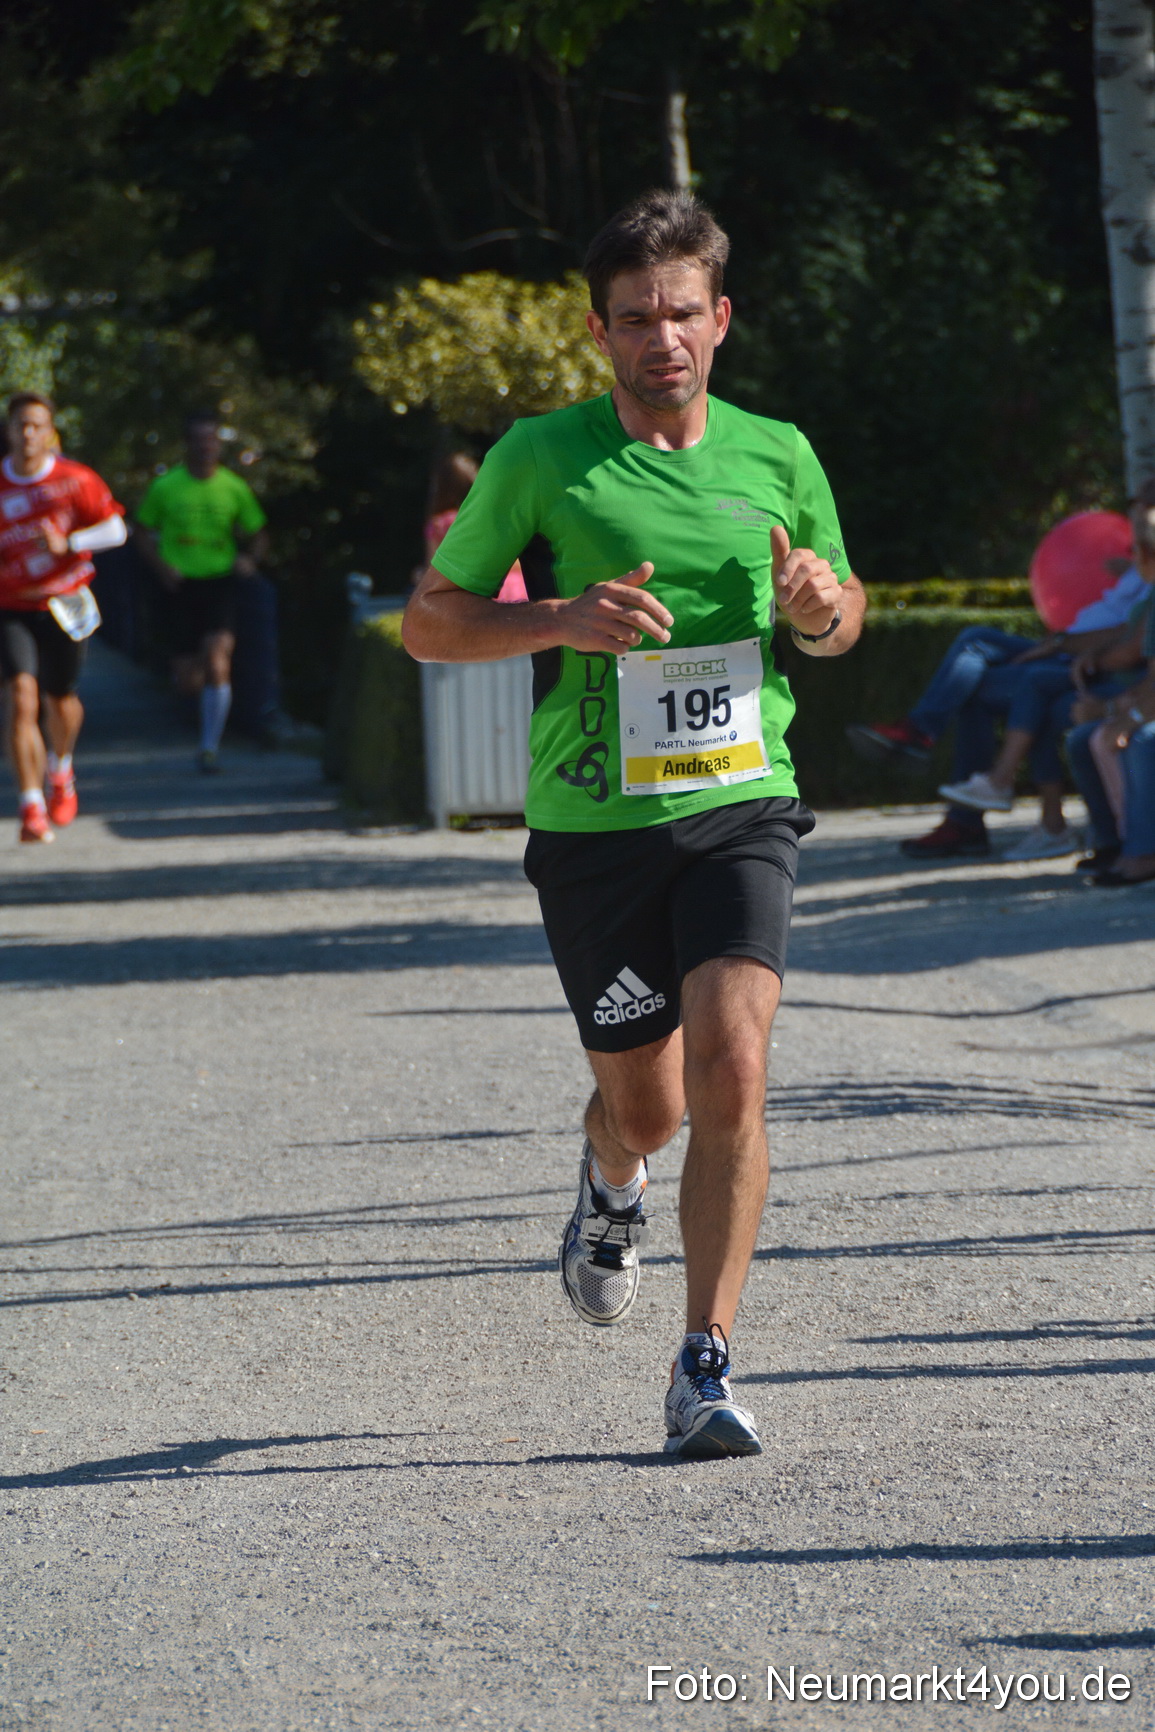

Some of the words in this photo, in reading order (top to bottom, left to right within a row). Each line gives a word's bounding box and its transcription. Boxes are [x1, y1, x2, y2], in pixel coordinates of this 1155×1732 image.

[663, 658, 727, 677] BOCK
[658, 685, 732, 733] 195
[629, 727, 635, 735] B
[655, 741, 686, 750] PARTL
[688, 735, 727, 747] Neumarkt
[662, 756, 731, 777] Andreas
[593, 992, 666, 1025] adidas
